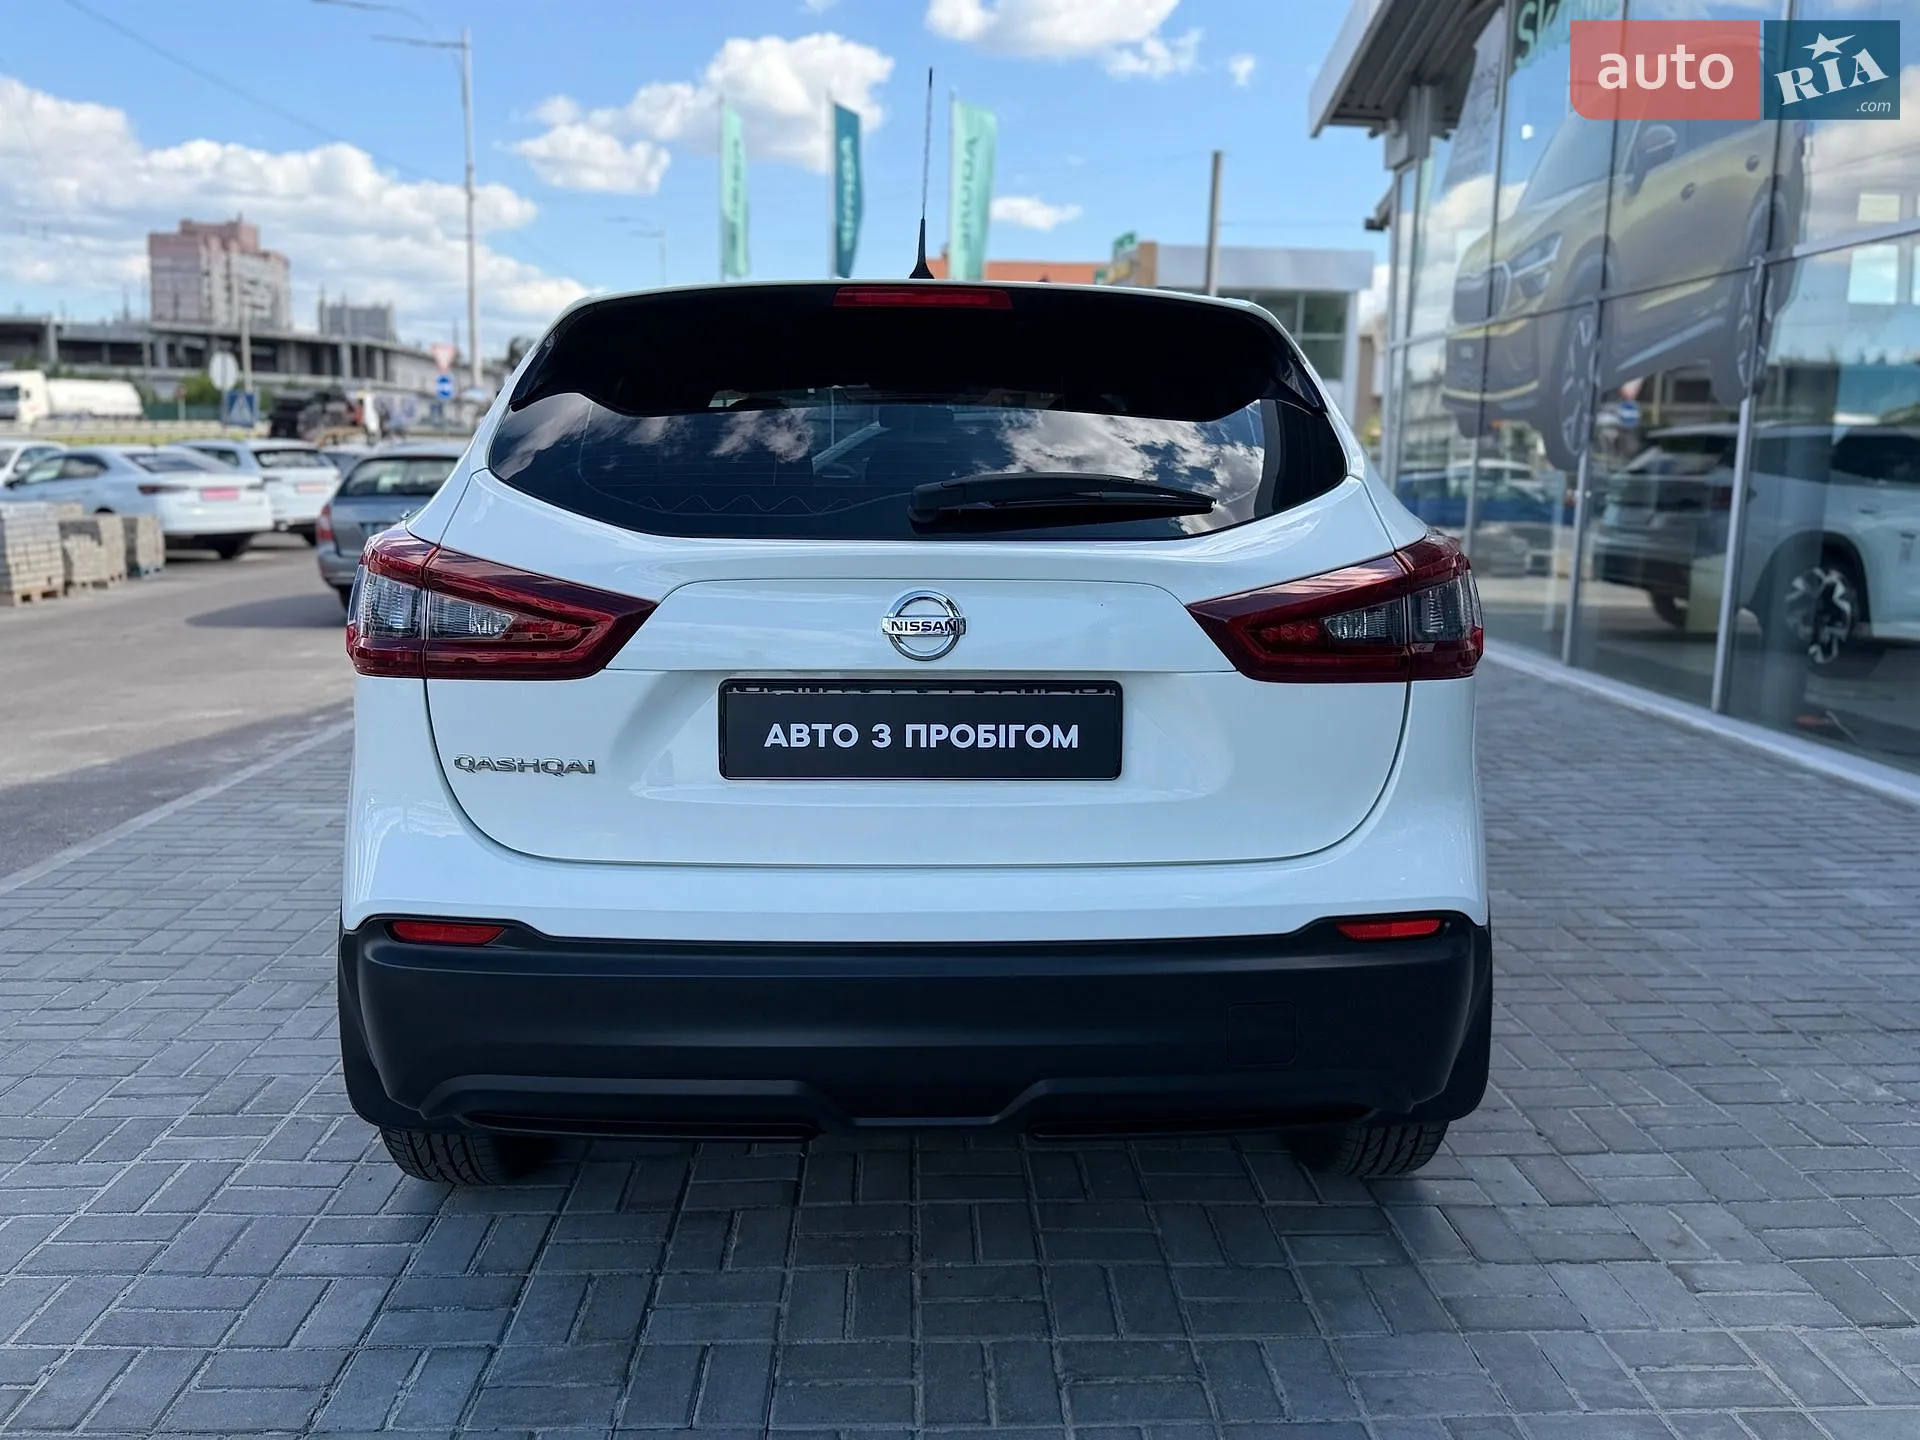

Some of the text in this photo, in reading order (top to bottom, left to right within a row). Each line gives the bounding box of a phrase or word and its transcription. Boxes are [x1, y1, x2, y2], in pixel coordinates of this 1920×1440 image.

[890, 619, 959, 634] NISSAN
[763, 723, 1080, 749] АВТО З ПРОБІГОМ
[453, 754, 596, 777] QASHQAI
